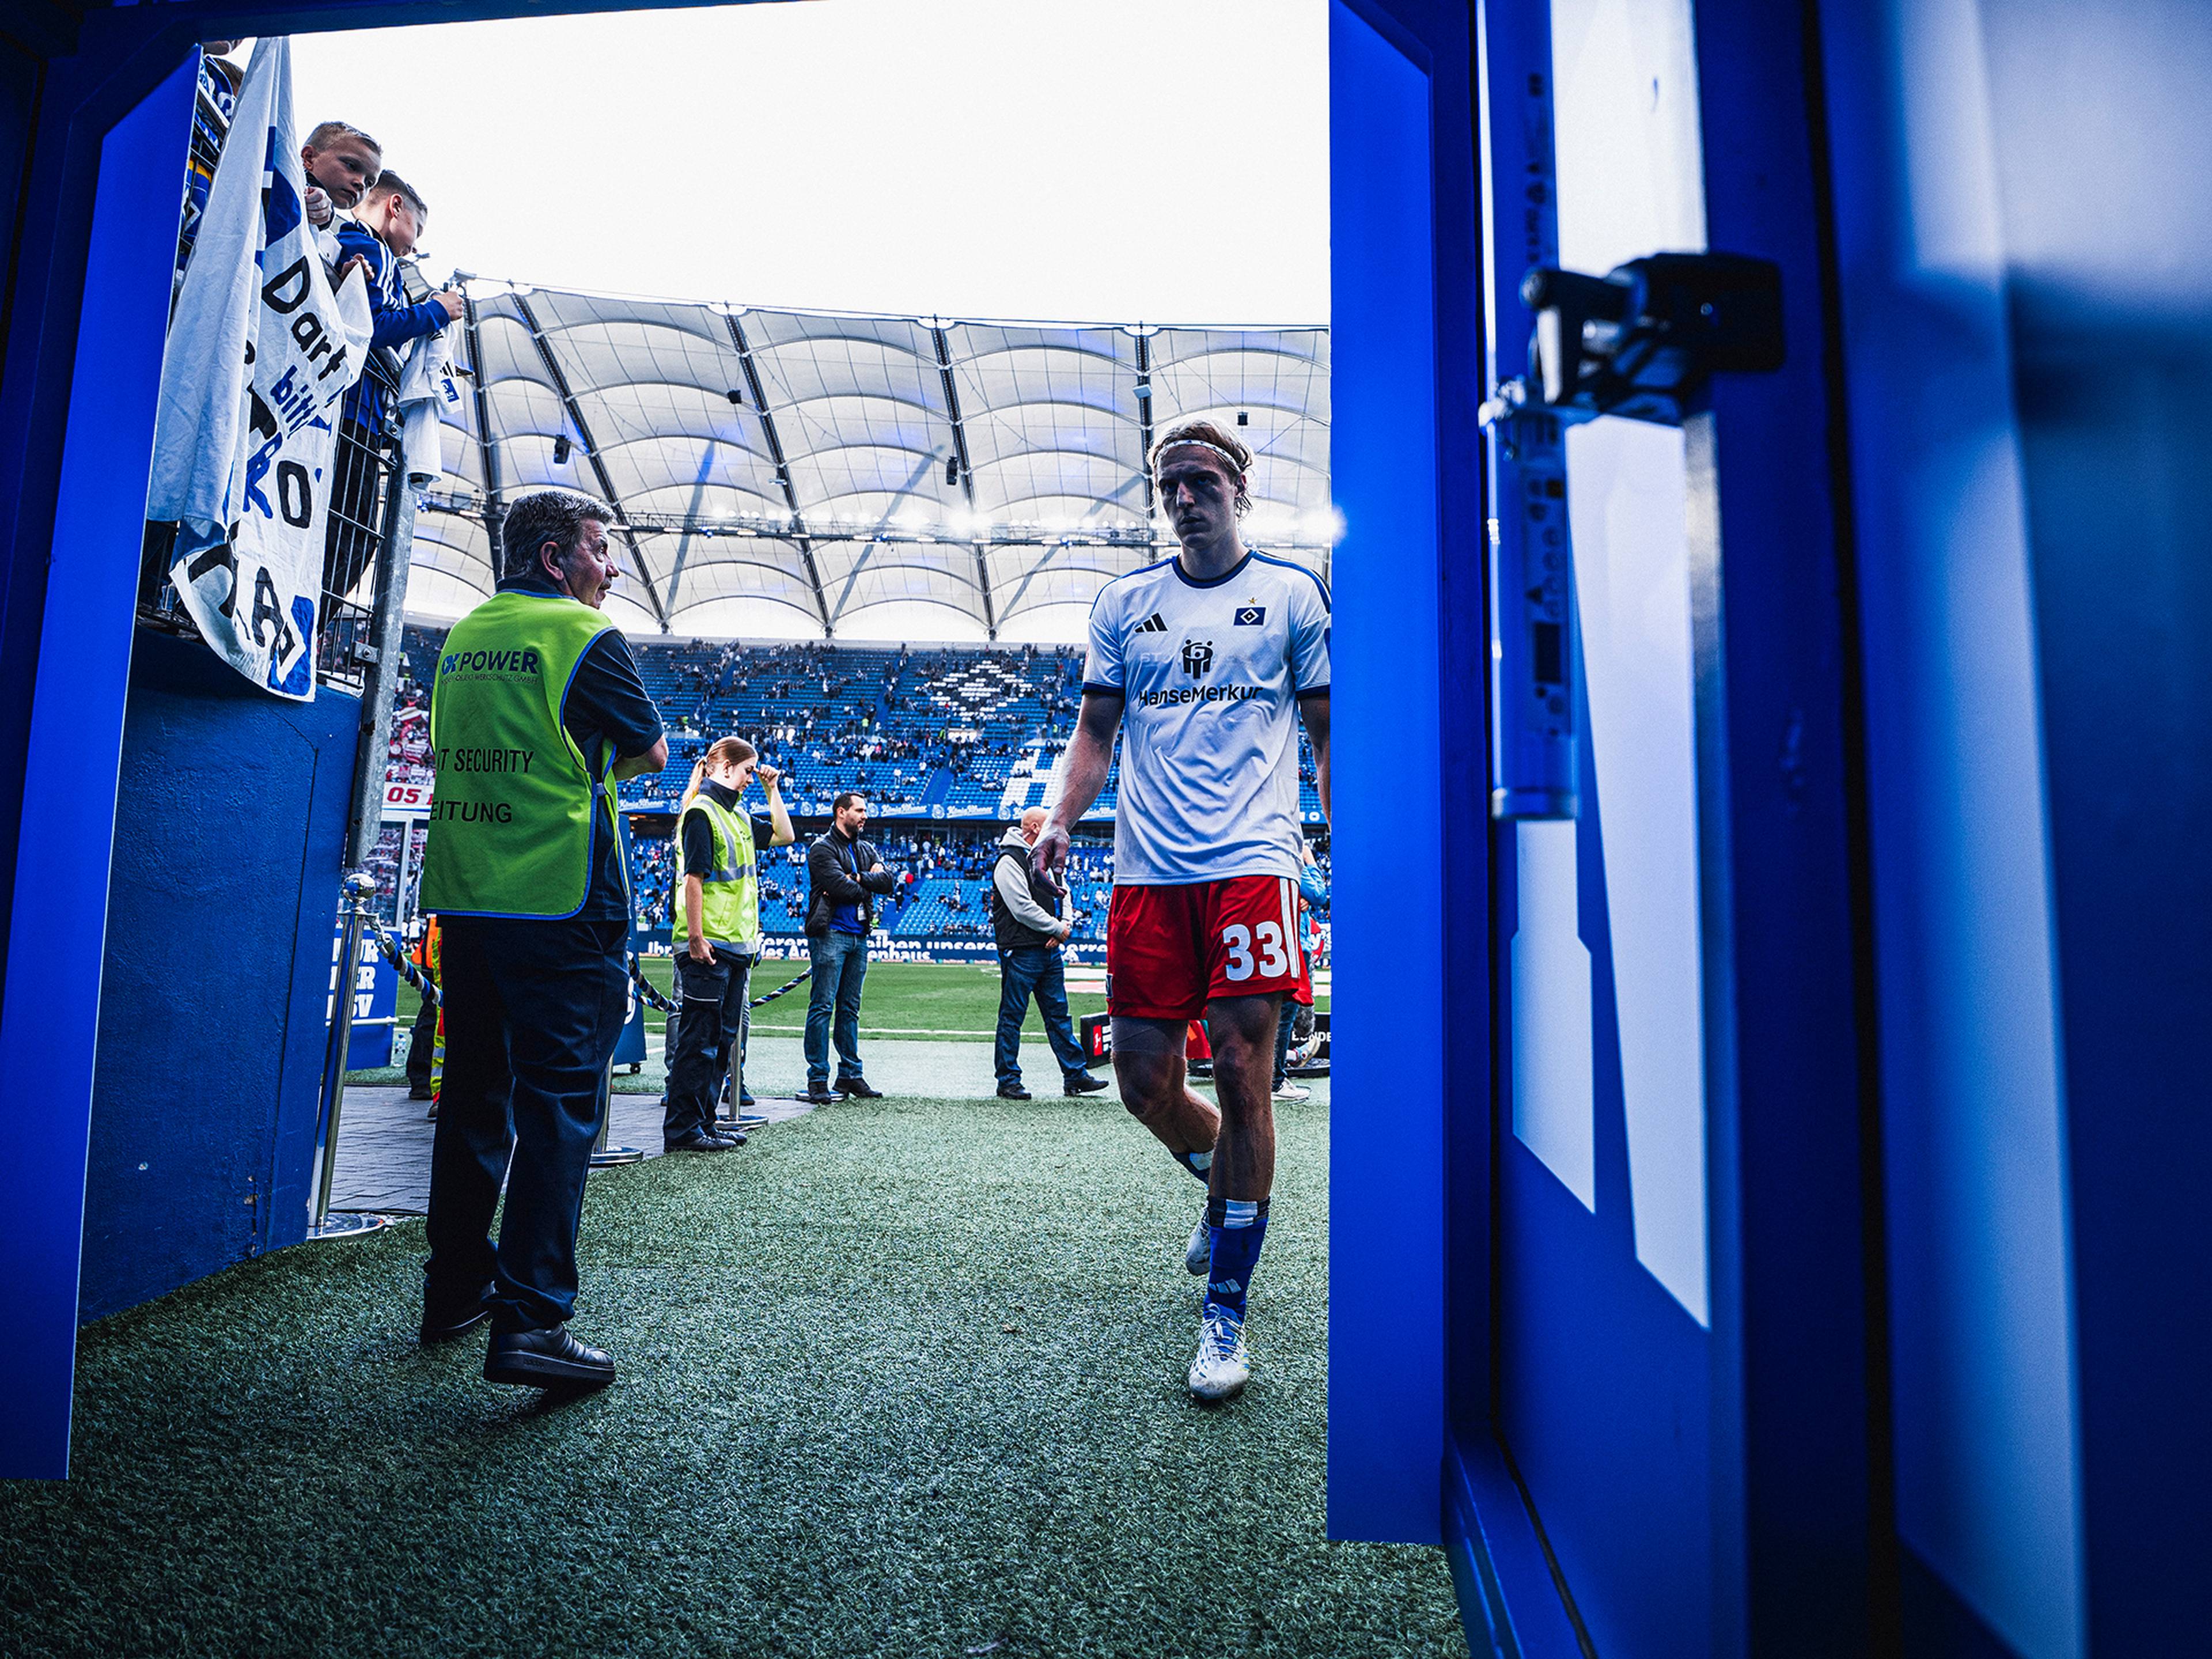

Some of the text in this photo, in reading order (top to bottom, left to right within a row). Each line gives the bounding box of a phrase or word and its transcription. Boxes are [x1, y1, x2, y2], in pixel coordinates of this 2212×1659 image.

[459, 650, 539, 675] POWER
[1138, 684, 1263, 706] HanseMerkur
[454, 748, 534, 773] SECURITY
[387, 787, 422, 804] 05
[1222, 921, 1287, 980] 33
